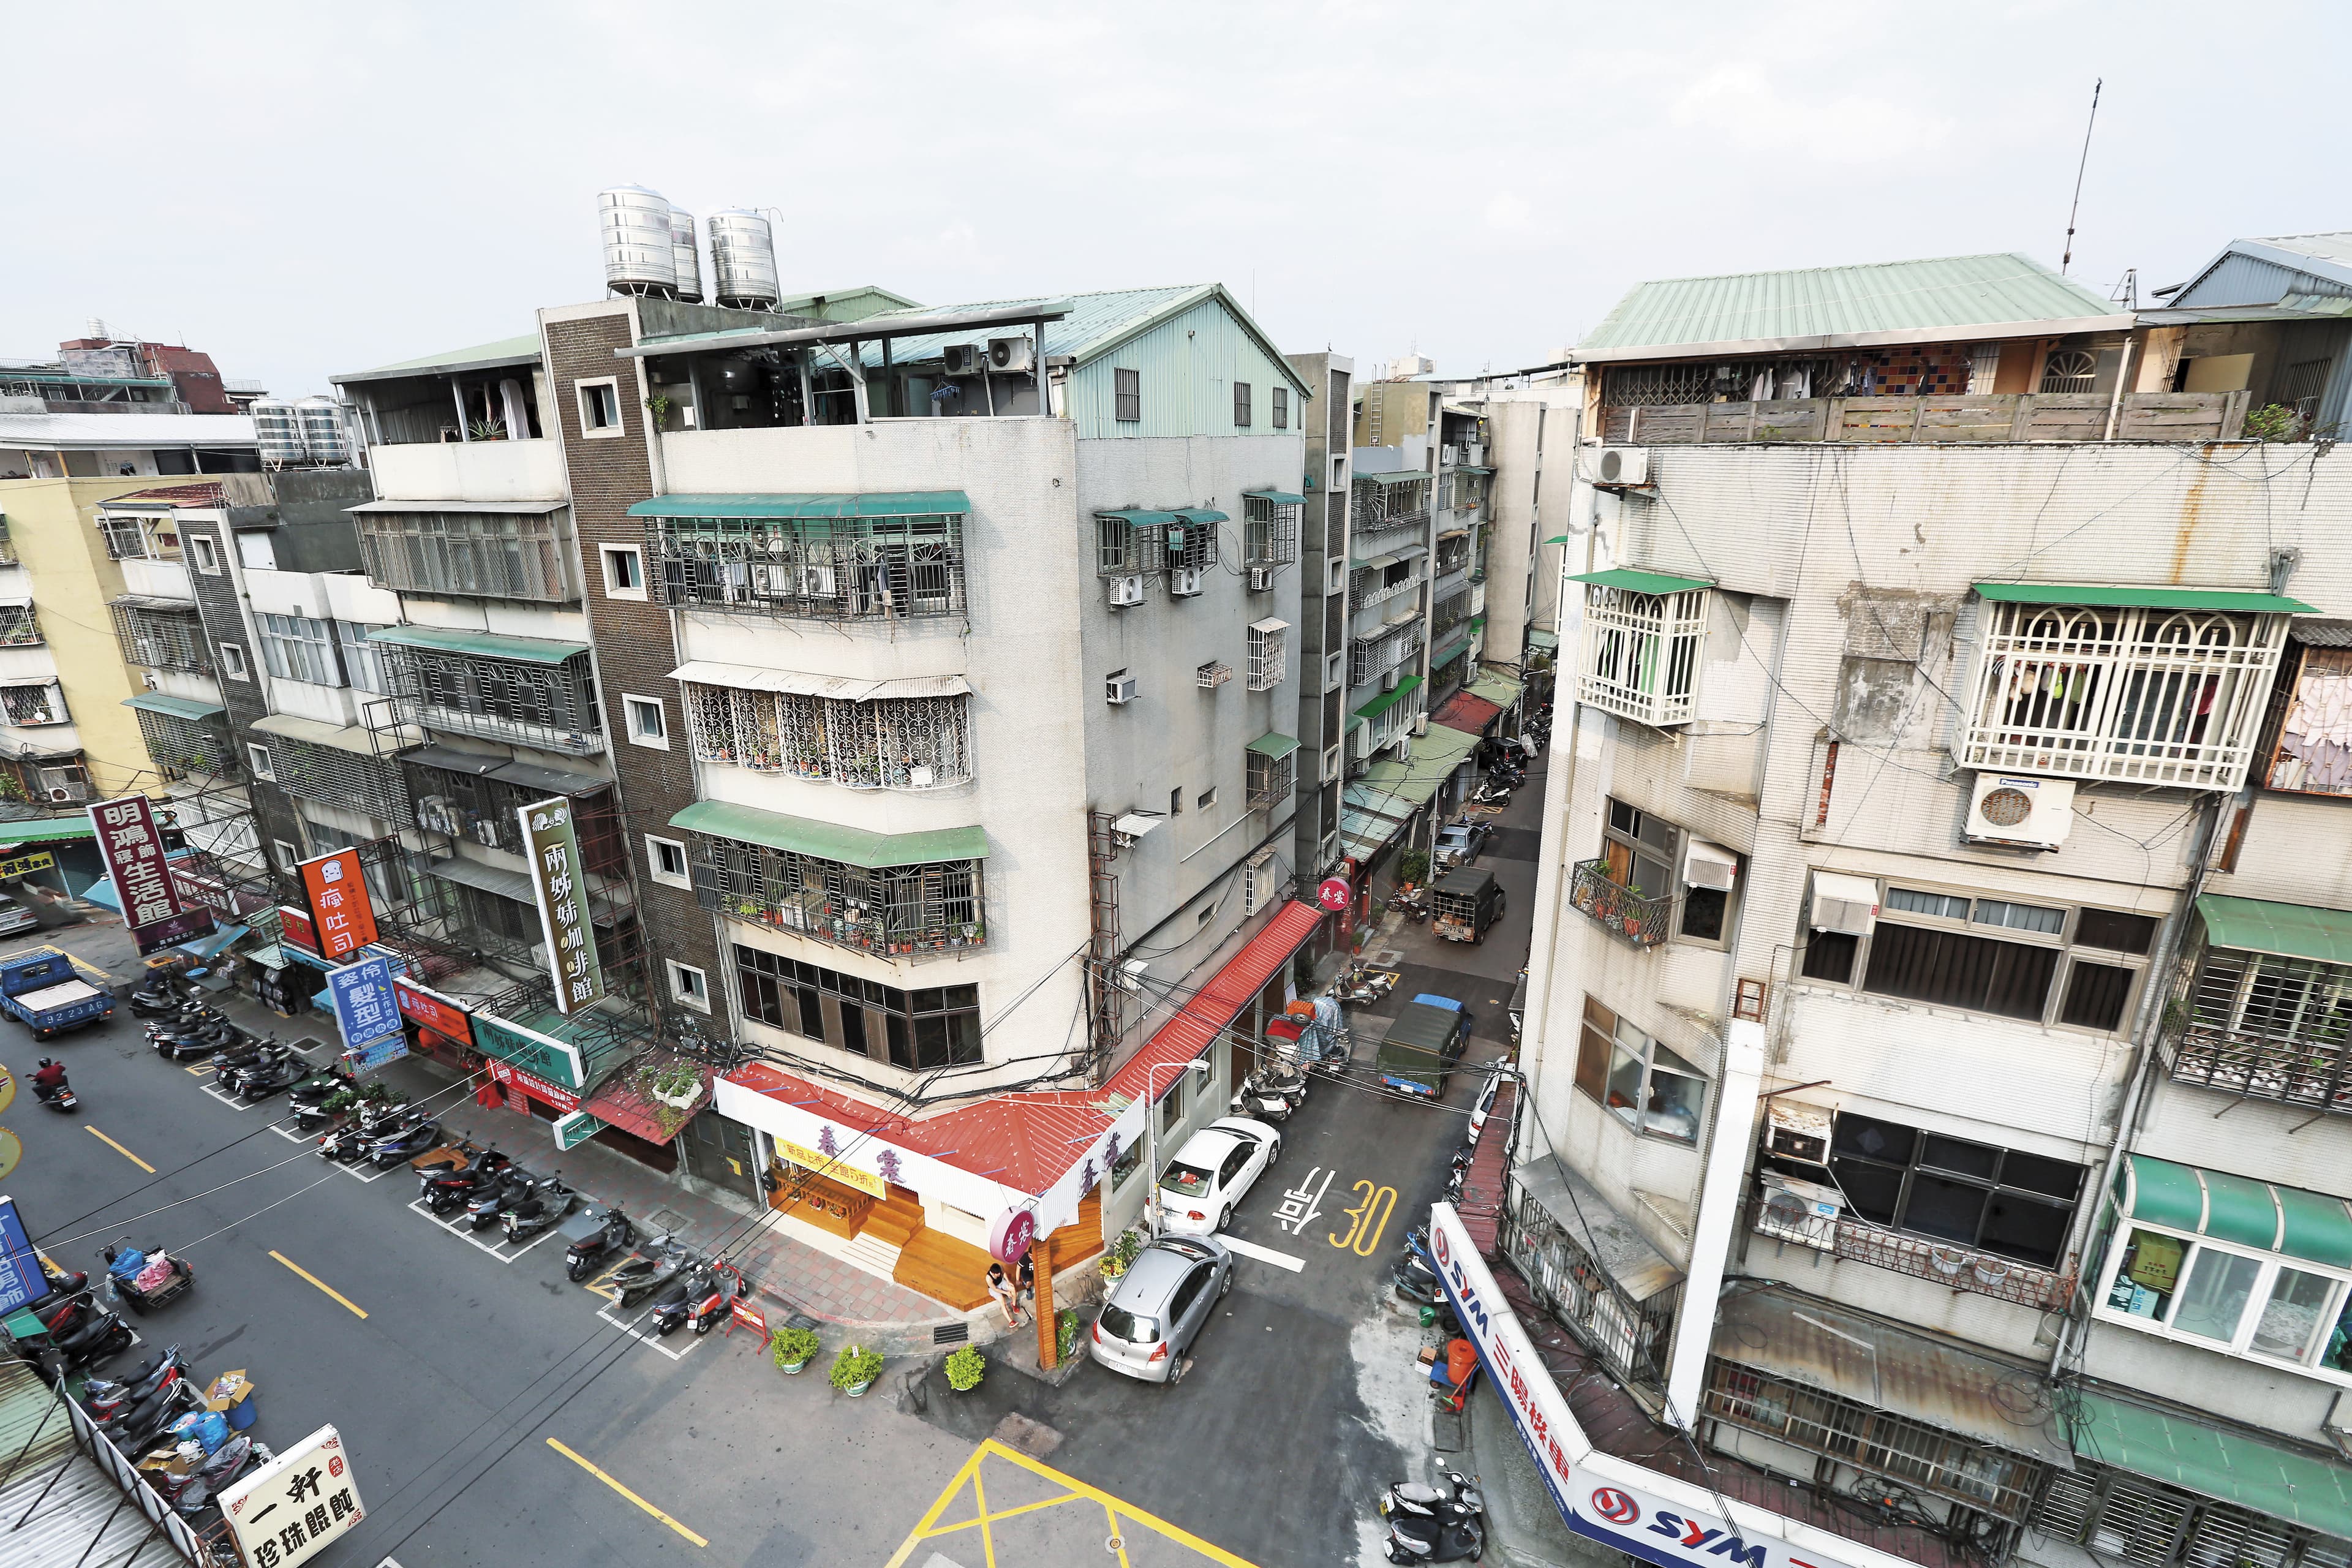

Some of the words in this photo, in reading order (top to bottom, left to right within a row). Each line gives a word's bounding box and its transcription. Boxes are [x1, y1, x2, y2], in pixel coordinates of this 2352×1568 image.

[2001, 779, 2038, 788] Panasonic
[320, 888, 354, 952] 瘋吐司
[543, 840, 594, 1003] 兩姊妹咖啡館
[1321, 886, 1346, 905] 春裳
[349, 982, 383, 1028] 髮型
[380, 991, 394, 1017] 工作坊
[412, 997, 438, 1018] 瘋吐司
[786, 1144, 825, 1167] 新品上市
[818, 1125, 907, 1184] 春裳
[1272, 1166, 1336, 1236] 停
[1329, 1179, 1398, 1257] 30
[1005, 1219, 1031, 1257] 春裳
[1450, 1260, 1488, 1339] SYM
[1493, 1333, 1570, 1485] 三陽機車
[330, 1457, 344, 1477] 老店
[254, 1487, 355, 1568] 珍珠餛飩
[1646, 1510, 1768, 1568] SYM
